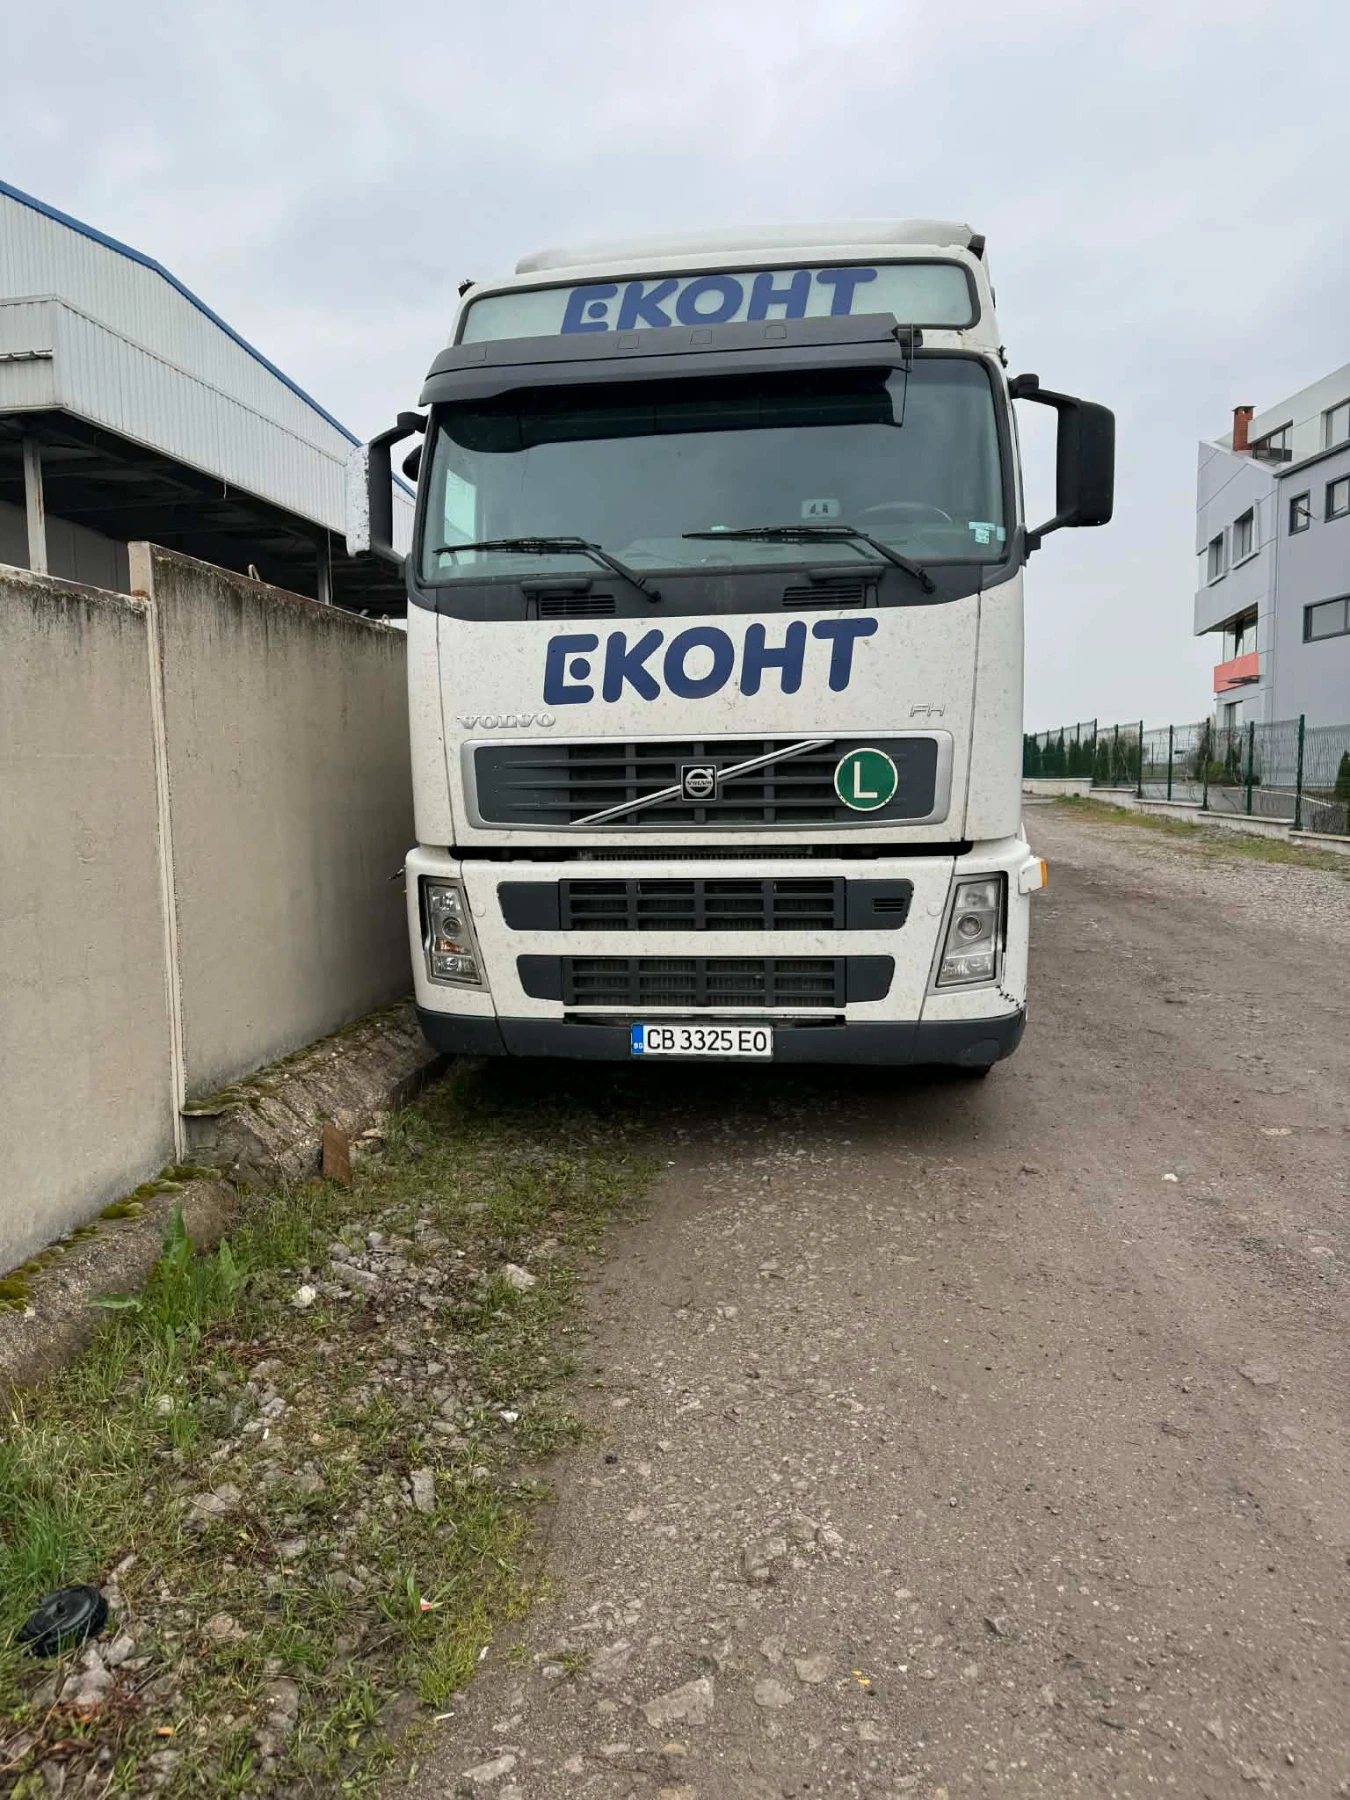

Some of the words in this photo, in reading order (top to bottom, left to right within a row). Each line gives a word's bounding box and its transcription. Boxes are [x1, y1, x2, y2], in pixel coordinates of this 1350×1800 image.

[543, 617, 878, 705] ЕКОНТ
[909, 702, 946, 717] FH
[457, 713, 556, 730] VOLVO
[853, 761, 878, 798] L
[647, 1029, 675, 1050] CB
[680, 1030, 733, 1051] 3325
[738, 1031, 767, 1052] EO
